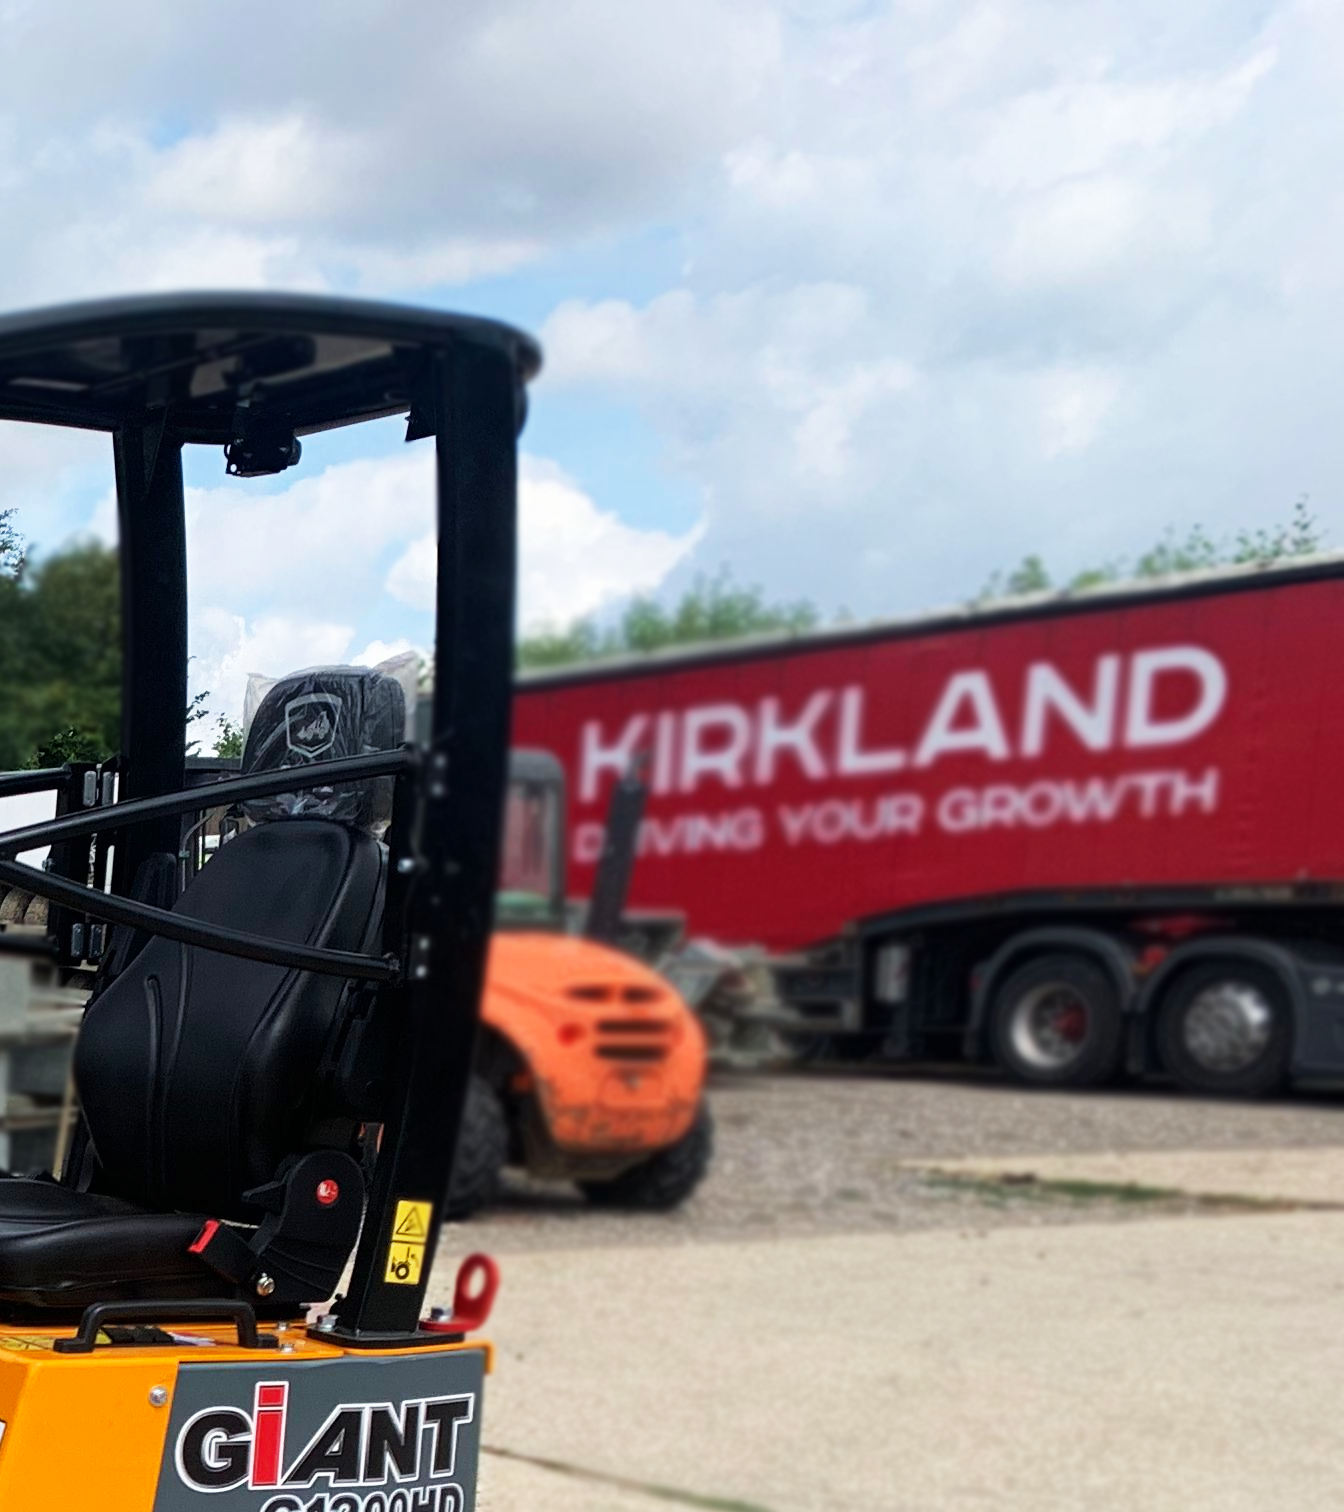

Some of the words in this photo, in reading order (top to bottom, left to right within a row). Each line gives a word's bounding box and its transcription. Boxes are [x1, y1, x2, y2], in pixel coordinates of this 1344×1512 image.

[579, 645, 1228, 801] KIRKLAND
[575, 808, 764, 862] DIVING
[782, 794, 925, 843] YOUR
[937, 769, 1219, 834] GROWTH
